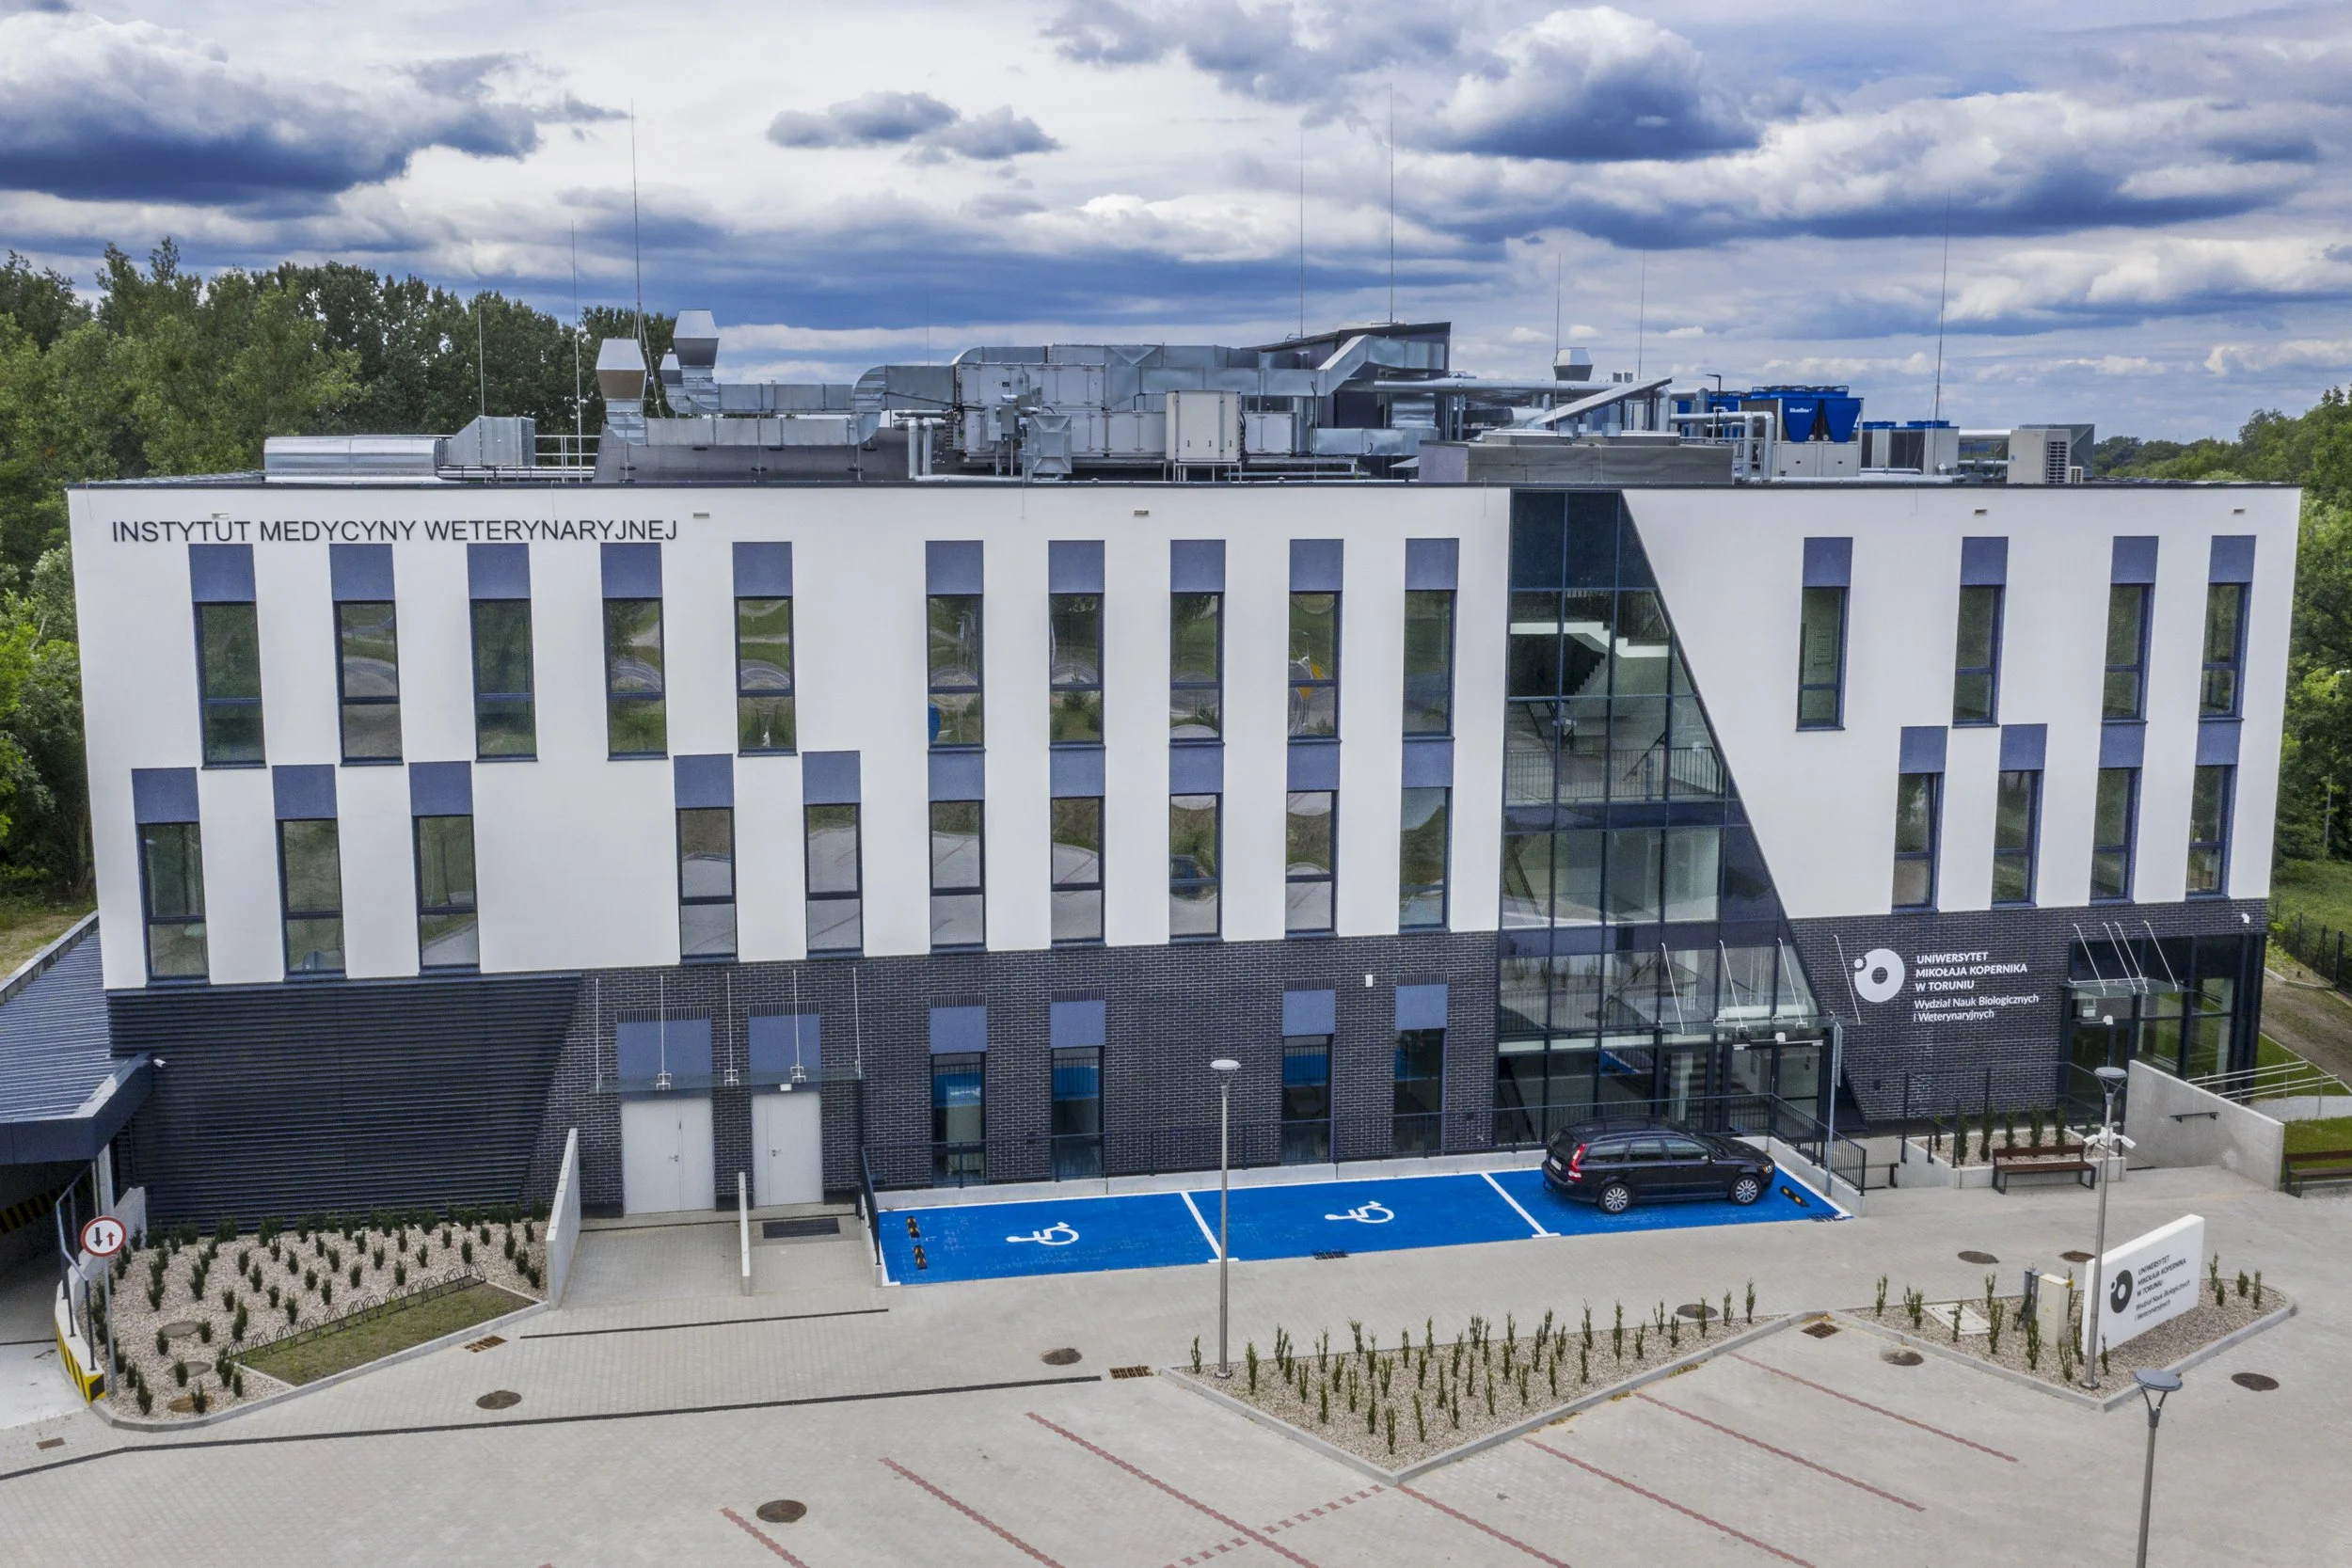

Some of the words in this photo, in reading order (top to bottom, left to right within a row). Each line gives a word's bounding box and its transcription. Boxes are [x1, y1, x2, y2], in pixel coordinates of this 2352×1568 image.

[112, 520, 251, 543] INSTYTUT
[261, 520, 416, 542] MEDYCYNY
[424, 519, 676, 542] WETERYNARYJNEJ
[1916, 952, 1989, 964] UNIWERSYTET
[1915, 967, 1967, 978] MIKOŁAJA
[1969, 963, 2028, 975] KOPERNIKA
[1915, 982, 1926, 992] W
[1929, 980, 1975, 990] TORUNIU
[1914, 998, 1951, 1010] Wydział
[1952, 997, 1977, 1007] Nauk
[1979, 994, 2040, 1006] Biologicznych
[1918, 1009, 1994, 1022] Weterynaryjnych
[2138, 1255, 2170, 1275] UNIWERSYTET
[2161, 1258, 2186, 1275] KOPERNIKA
[2142, 1279, 2164, 1294] TORUNIU
